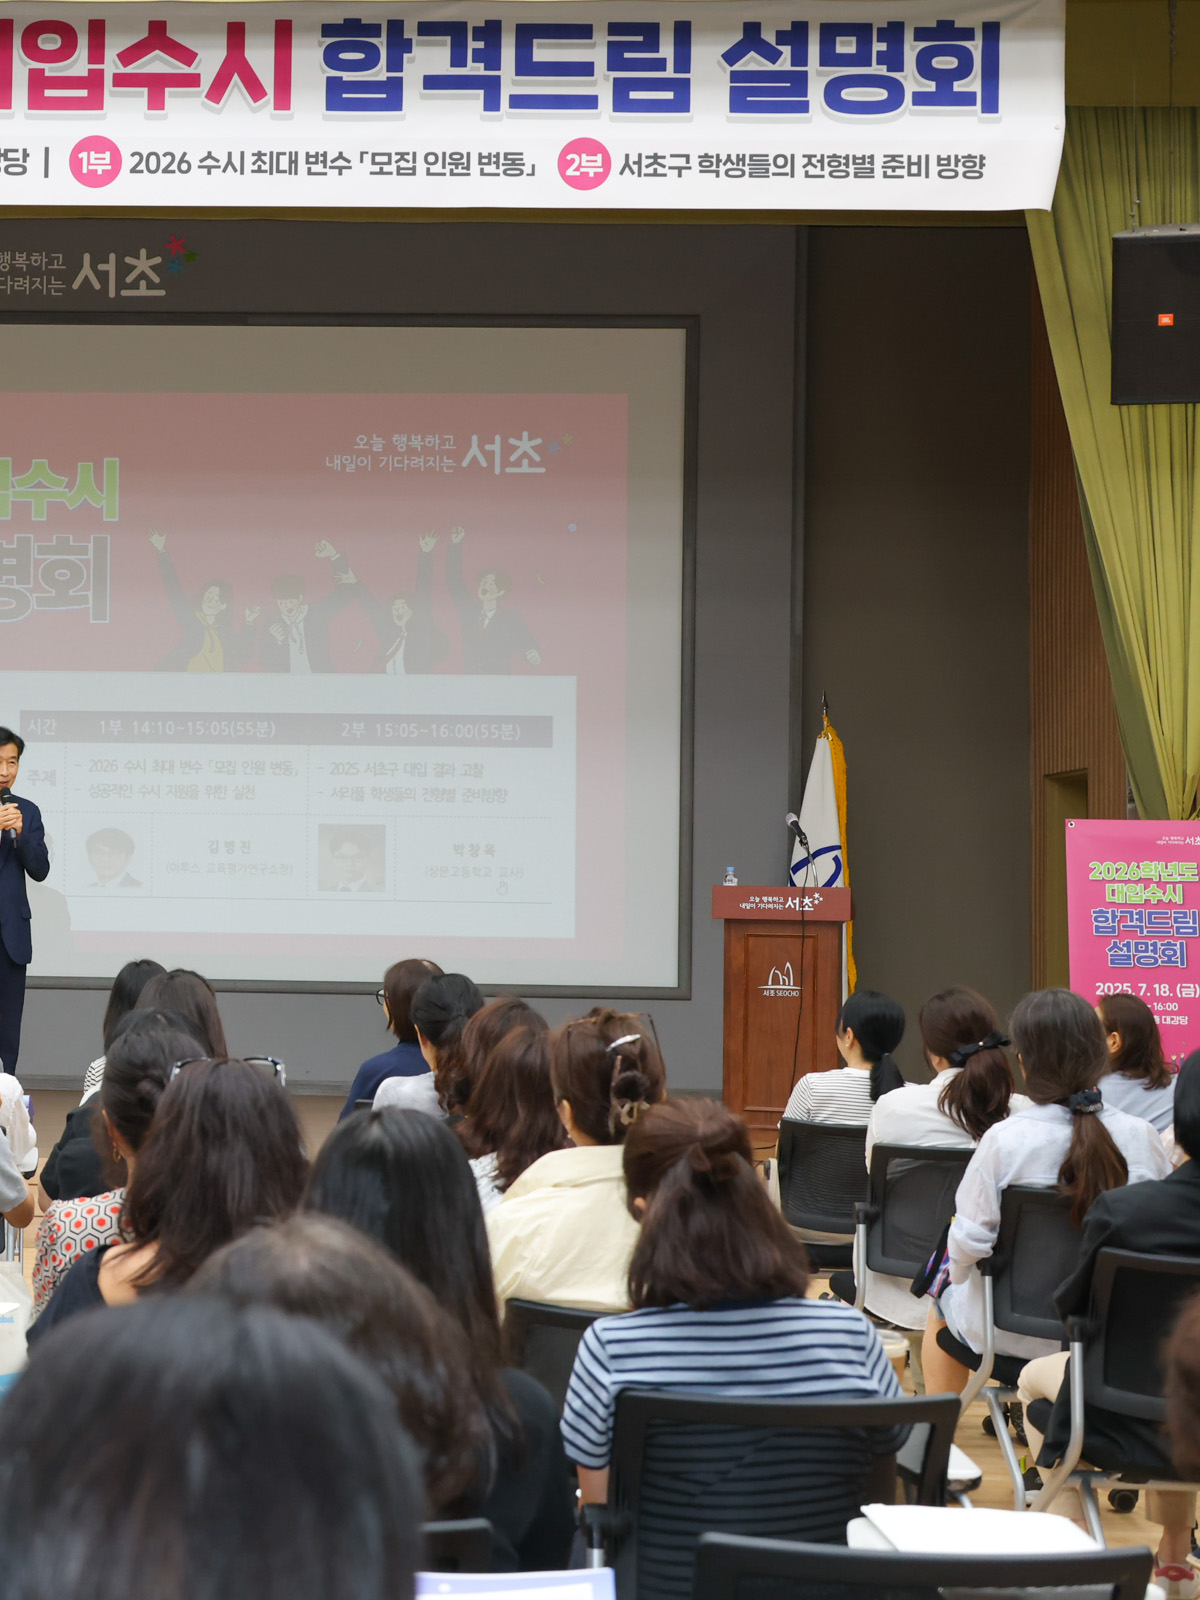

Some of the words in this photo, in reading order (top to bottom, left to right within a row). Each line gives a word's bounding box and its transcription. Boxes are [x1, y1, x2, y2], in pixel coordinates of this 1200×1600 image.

[321, 17, 692, 115] 합격드림
[720, 19, 1001, 115] 설명회
[77, 150, 112, 175] 1부
[129, 151, 192, 175] 2026
[197, 150, 246, 176] 수시
[250, 150, 300, 176] 최대
[304, 150, 353, 177] 변수
[422, 151, 472, 177] 인원
[564, 153, 604, 178] 2부
[618, 153, 693, 179] 서초구
[697, 153, 796, 179] 학생들의
[801, 153, 876, 179] 전형별
[880, 153, 930, 180] 준비
[936, 153, 987, 180] 방향
[71, 248, 167, 298] 서초
[353, 434, 386, 452] 오늘
[392, 434, 457, 452] 행복하고
[461, 431, 547, 475] 서초
[325, 455, 372, 472] 내일이
[378, 455, 457, 473] 기다려지는
[28, 718, 58, 736] 시간
[99, 719, 123, 736] 1부
[132, 719, 277, 738] 14:10~15:05(55분)
[341, 722, 366, 739] 2부
[375, 722, 521, 741] 15:05~16:00(55분)
[27, 768, 57, 787] 주제
[88, 759, 118, 774] 2026
[123, 759, 147, 775] 수시
[151, 759, 175, 776] 최대
[180, 759, 203, 777] 변수
[241, 760, 266, 777] 인원
[330, 761, 359, 777] 2025
[364, 762, 399, 778] 서초구
[403, 762, 428, 778] 대입
[88, 782, 133, 799] 성공적인
[137, 783, 161, 799] 수시
[1089, 861, 1199, 882] 2026학년도
[785, 896, 815, 911] 서초
[1105, 883, 1184, 904] 대입수시
[1091, 908, 1200, 936] 합격드림
[1106, 940, 1188, 968] 설명회
[1153, 1002, 1179, 1011] 16:00
[1162, 1015, 1189, 1025] 대강당
